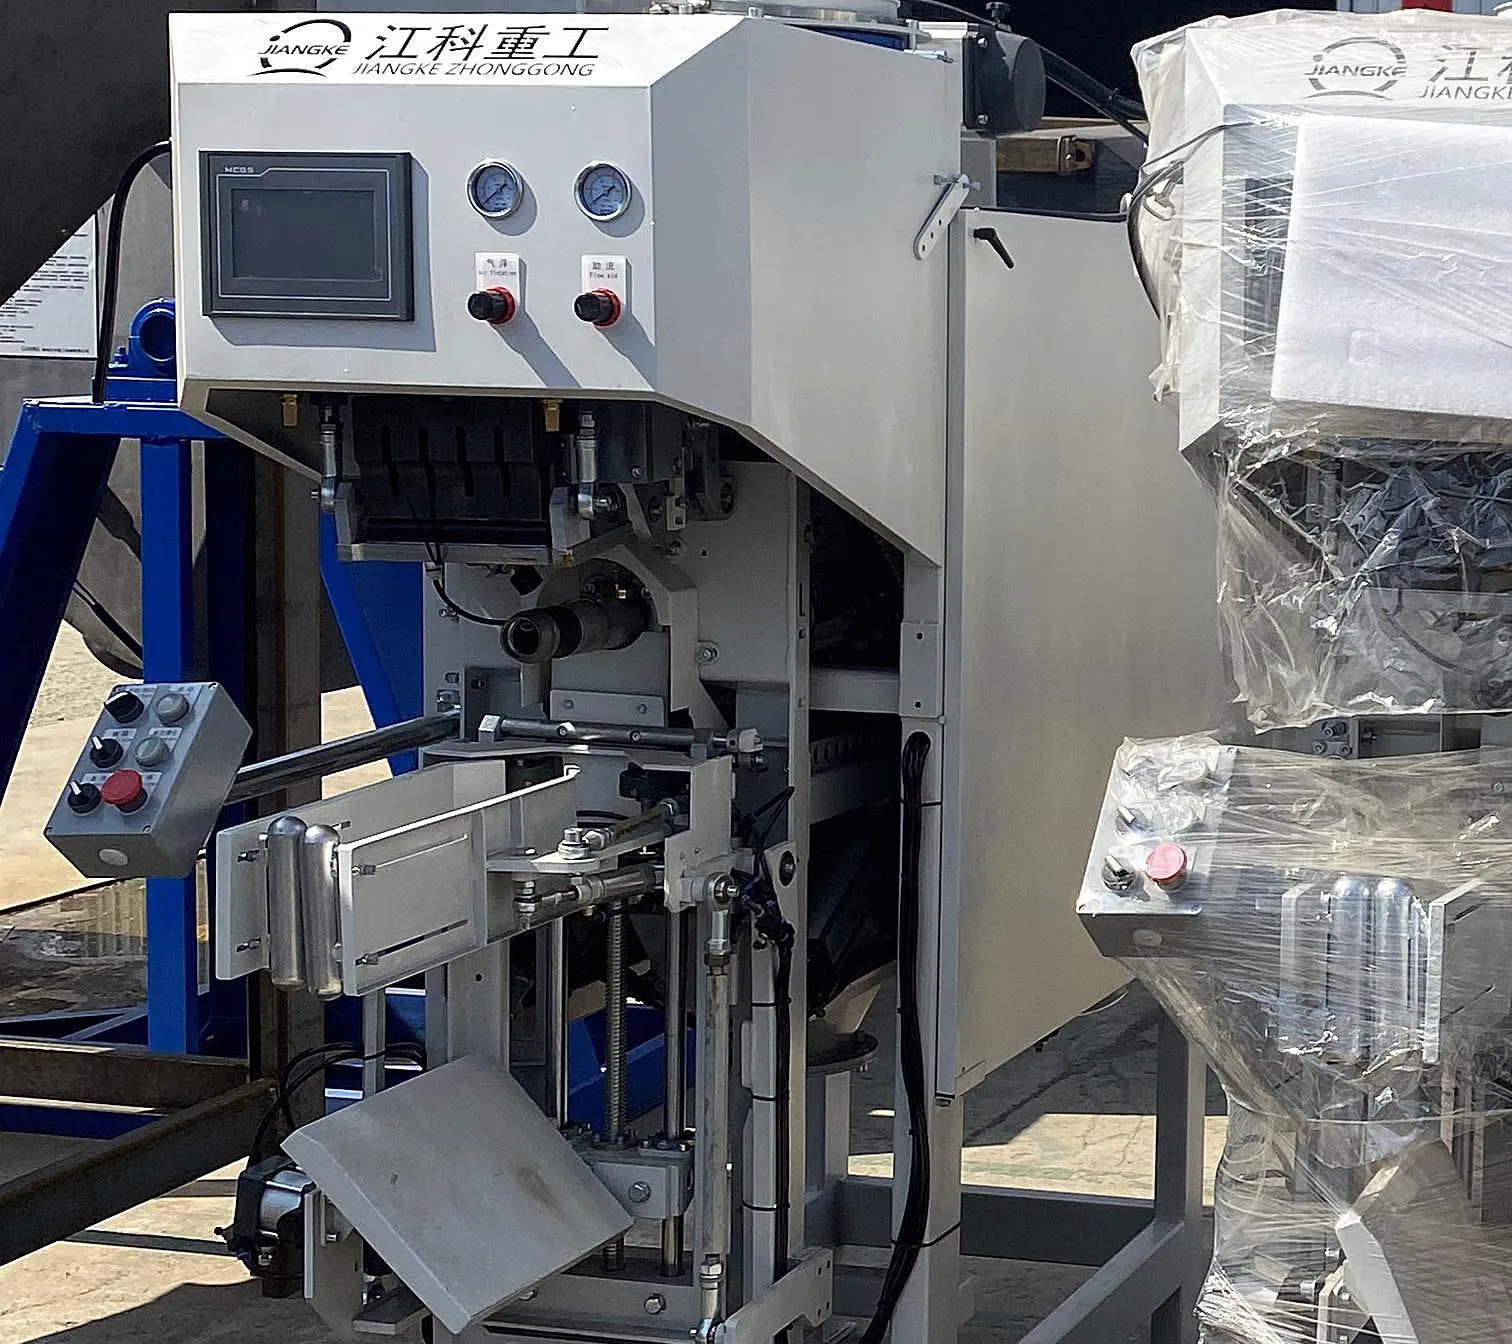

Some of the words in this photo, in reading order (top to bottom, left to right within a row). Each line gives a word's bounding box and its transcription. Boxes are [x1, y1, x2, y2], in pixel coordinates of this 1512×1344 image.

[258, 43, 350, 55] JIANGKE
[364, 23, 610, 61] 江科重工
[351, 62, 440, 76] JIANGKE
[444, 62, 597, 77] ZHONGGONG
[1303, 63, 1408, 77] JIANGKE
